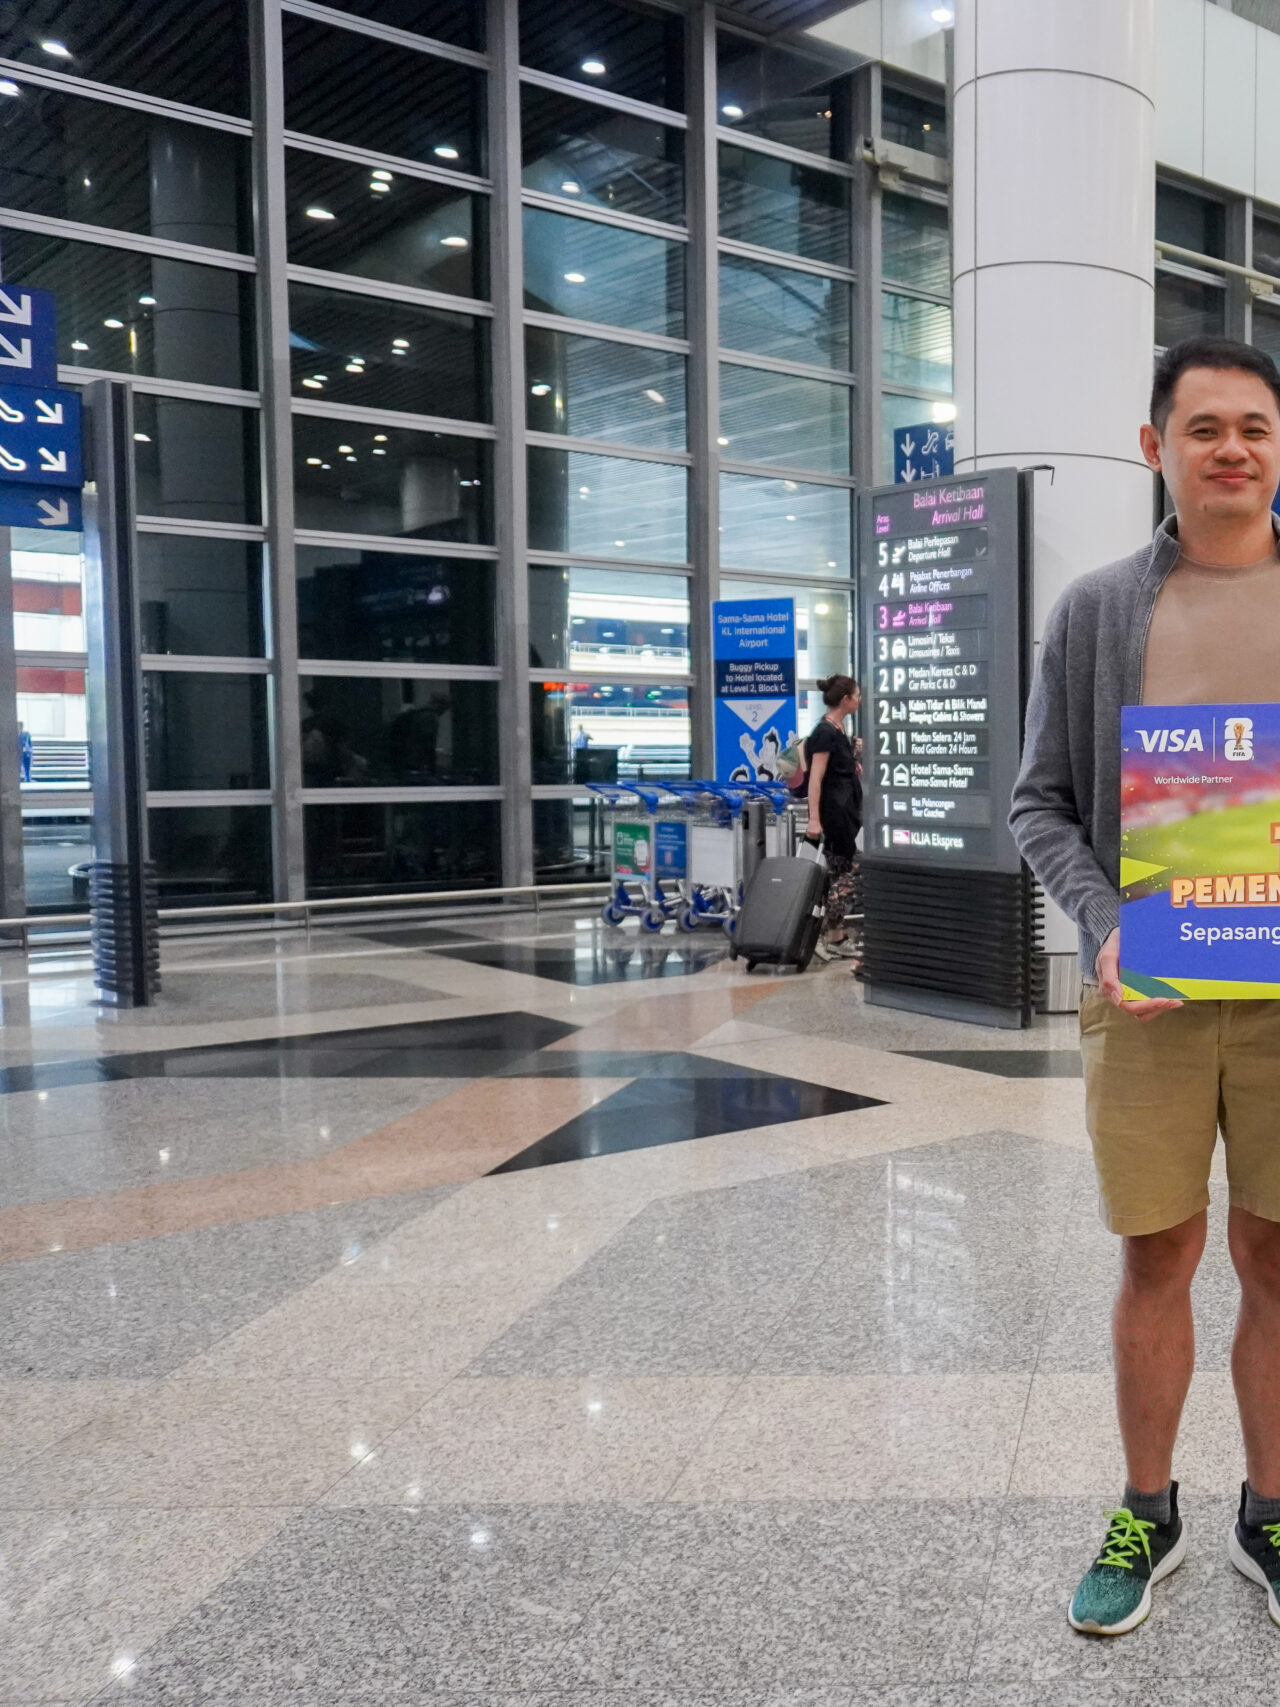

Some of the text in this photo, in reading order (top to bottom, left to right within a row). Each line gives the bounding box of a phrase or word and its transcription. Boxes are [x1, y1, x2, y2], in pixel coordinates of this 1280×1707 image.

[914, 487, 984, 508] Balai Ketibaan
[932, 504, 984, 526] Arrival Hall
[908, 536, 959, 549] Balai Perlepasan
[878, 542, 888, 567] 5
[908, 547, 951, 563] Departure Hall
[933, 568, 973, 579] Penerbangan
[879, 574, 888, 597] 4
[929, 581, 950, 592] Offices
[909, 604, 922, 614] Balai
[718, 612, 789, 623] Sama-Sama Hotel
[879, 606, 888, 629] 3
[909, 616, 927, 626] Arrival
[722, 625, 786, 636] KL International
[739, 638, 768, 649] Airport
[938, 633, 955, 644] Teksi
[879, 637, 888, 660] 3
[945, 646, 960, 656] Taxis
[729, 663, 778, 673] Buggy Pickup
[909, 665, 976, 678] Medan Kereta C & D
[735, 674, 754, 682] Hotel
[756, 672, 782, 681] located
[879, 669, 889, 692] 2
[729, 684, 748, 692] Level
[937, 679, 942, 689] C
[950, 679, 956, 689] D
[751, 711, 758, 722] 2
[879, 700, 890, 723] 2
[879, 732, 890, 754] 2
[911, 732, 931, 742] Medan
[932, 732, 952, 742] Selera
[953, 732, 962, 742] 24
[1134, 728, 1204, 752] VISA
[911, 744, 978, 754] Food Garden 24 Hours
[880, 763, 890, 786] 2
[911, 764, 974, 776] Hotel Sama-Sama
[911, 776, 968, 788] Sama-Sama Hotel
[1154, 775, 1233, 785] Worldwide Partner
[882, 794, 888, 817] 1
[882, 825, 889, 848] 1
[911, 832, 930, 845] KLIA
[932, 833, 964, 850] Ekspres
